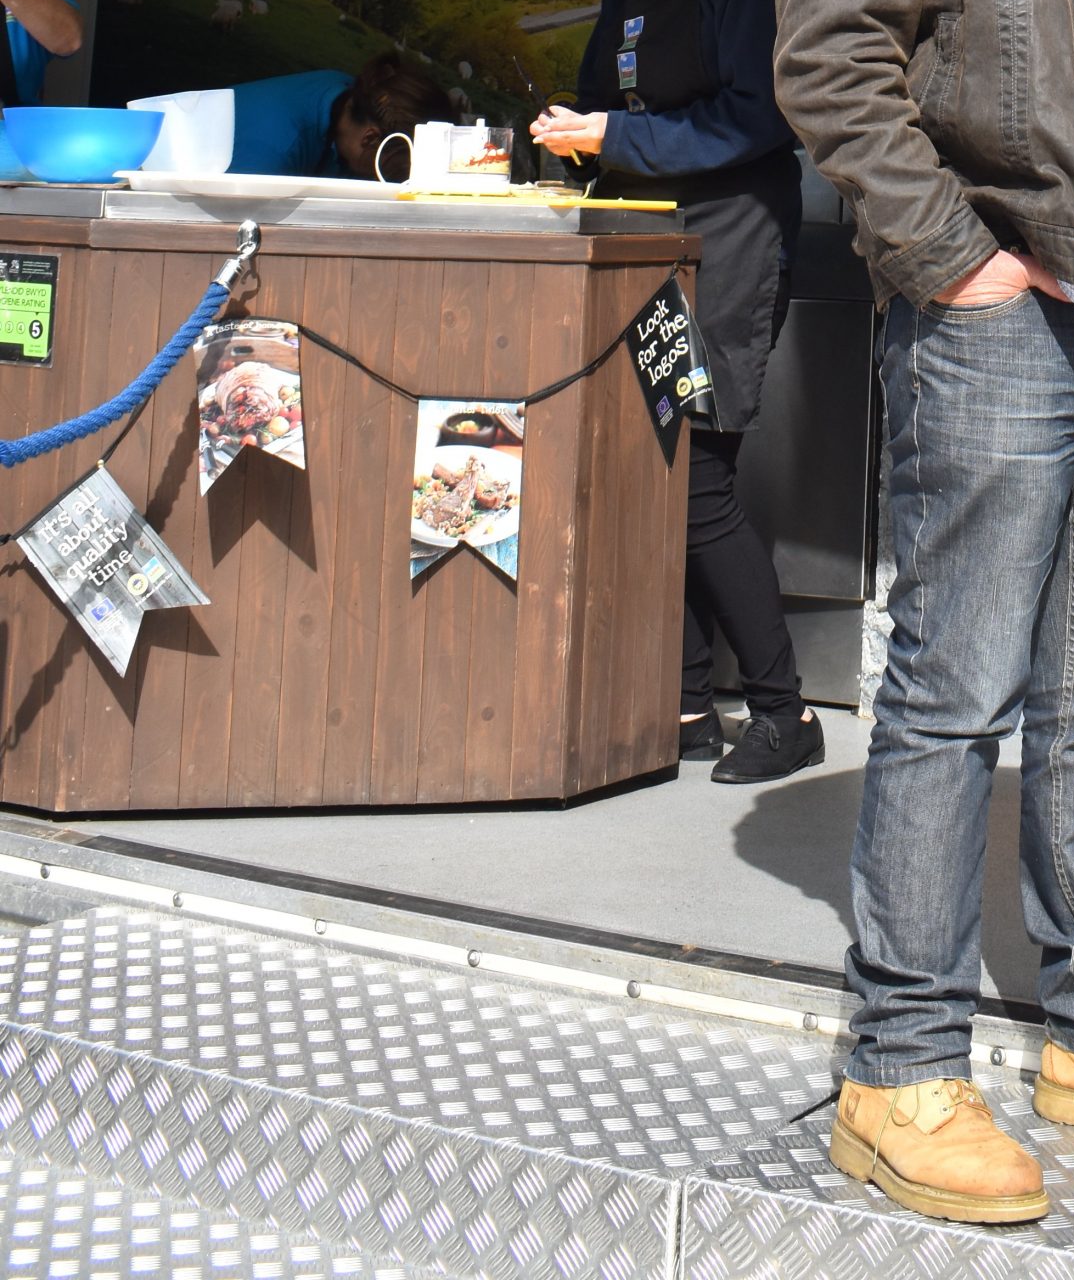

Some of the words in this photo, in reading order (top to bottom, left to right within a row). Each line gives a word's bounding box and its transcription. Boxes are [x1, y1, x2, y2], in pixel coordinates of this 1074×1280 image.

[22, 299, 46, 308] RATING
[637, 299, 670, 342] Look
[31, 321, 41, 338] 5
[638, 340, 658, 371] for
[659, 313, 689, 343] the
[647, 336, 689, 387] logos
[72, 486, 100, 516] all
[57, 507, 109, 556] about
[66, 521, 128, 580] quality
[87, 548, 134, 587] time
